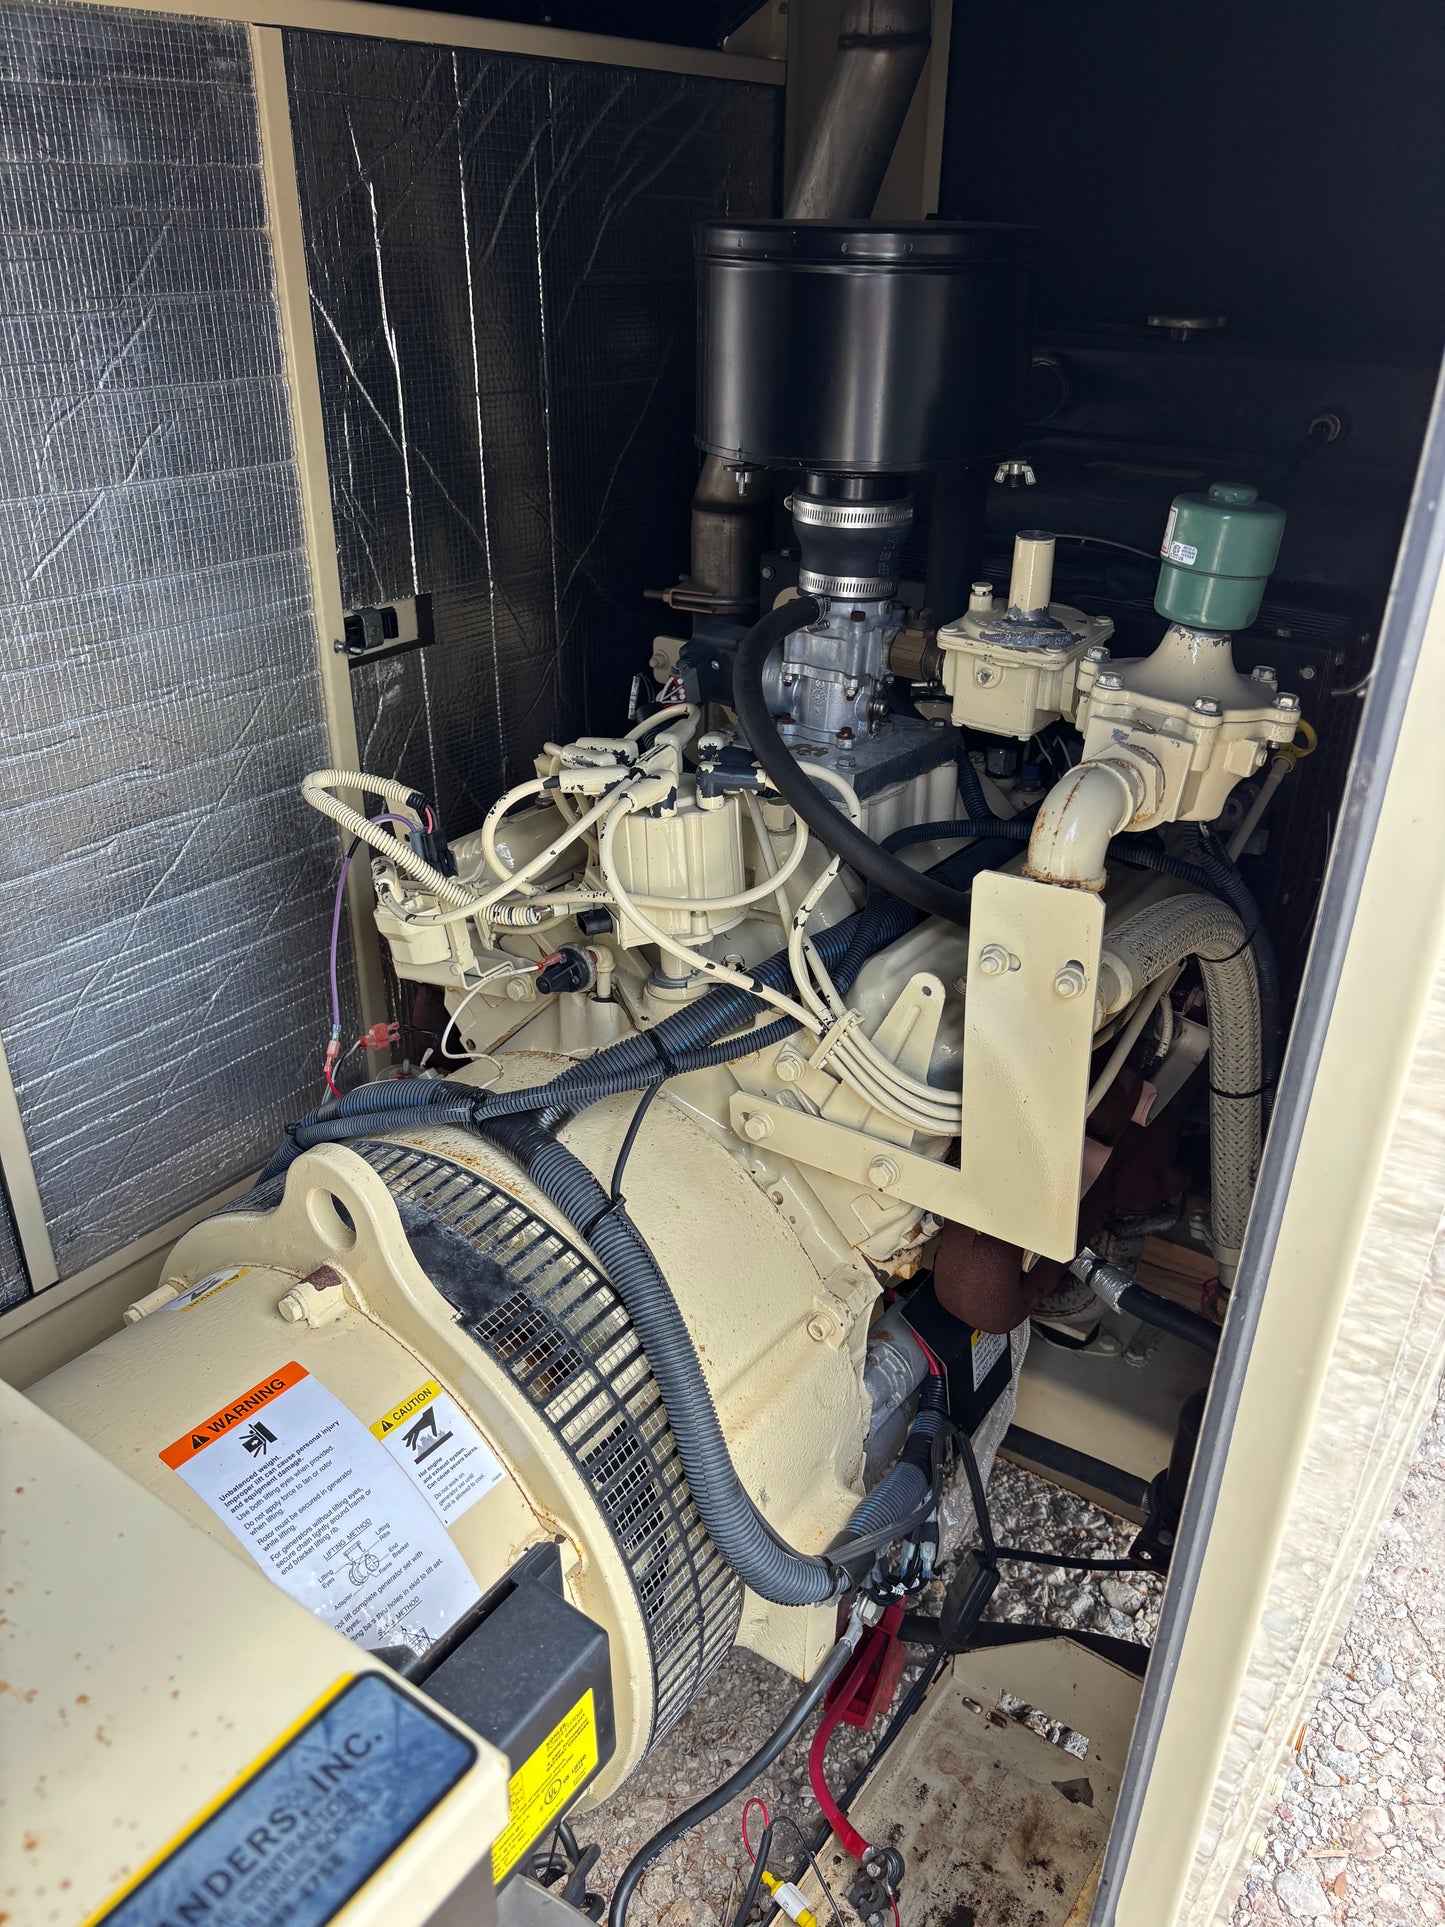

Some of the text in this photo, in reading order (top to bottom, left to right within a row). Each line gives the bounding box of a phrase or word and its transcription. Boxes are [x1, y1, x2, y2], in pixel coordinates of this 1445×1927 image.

[206, 1378, 286, 1433] WARNING
[392, 1387, 432, 1421] CAUTION
[218, 1455, 282, 1501] Unbalanced weight.
[223, 1420, 340, 1508] Improper lift can cause personal injury
[417, 1457, 443, 1478] Hot engine
[423, 1474, 432, 1484] and
[431, 1459, 450, 1476] exhaust
[426, 1480, 437, 1489] Can
[436, 1469, 450, 1481] cause
[449, 1456, 465, 1470] severe
[230, 1457, 304, 1513] and equipment damage.
[235, 1444, 335, 1521] Use both lifting eyes when provided.
[243, 1520, 255, 1530] Do
[254, 1511, 265, 1522] not
[264, 1499, 282, 1514] apply
[280, 1488, 296, 1501] force
[301, 1475, 313, 1485] fan
[318, 1459, 332, 1472] rotor
[256, 1468, 353, 1545] Rotor must be secured in generator
[249, 1521, 267, 1536] when
[269, 1487, 364, 1562] For generators without lifting eyes,
[275, 1488, 372, 1568] secure chain tightly around frame or
[322, 1518, 373, 1560] LIFTING METHOD
[374, 1522, 390, 1536] Lifting
[378, 1530, 390, 1541] Ribs
[262, 1537, 279, 1552] while
[280, 1562, 294, 1575] end
[291, 1545, 315, 1565] bracket
[313, 1533, 331, 1548] lifting
[387, 1542, 399, 1553] End
[391, 1542, 410, 1558] Bracket
[317, 1569, 334, 1583] Lifting
[321, 1577, 335, 1589] Eyes
[343, 1612, 353, 1622] lift
[351, 1591, 378, 1615] complete
[376, 1568, 403, 1594] generator
[402, 1559, 412, 1570] set
[411, 1550, 423, 1562] with
[375, 1607, 389, 1620] thru
[386, 1593, 403, 1609] holes
[401, 1588, 409, 1596] in
[408, 1577, 421, 1590] skid
[425, 1566, 434, 1574] lift
[432, 1558, 444, 1569] set.
[334, 1592, 353, 1611] Adapter
[394, 1595, 422, 1620] METHOD
[345, 1618, 362, 1633] eyes.
[156, 1732, 383, 1927] NDERS, INC.
